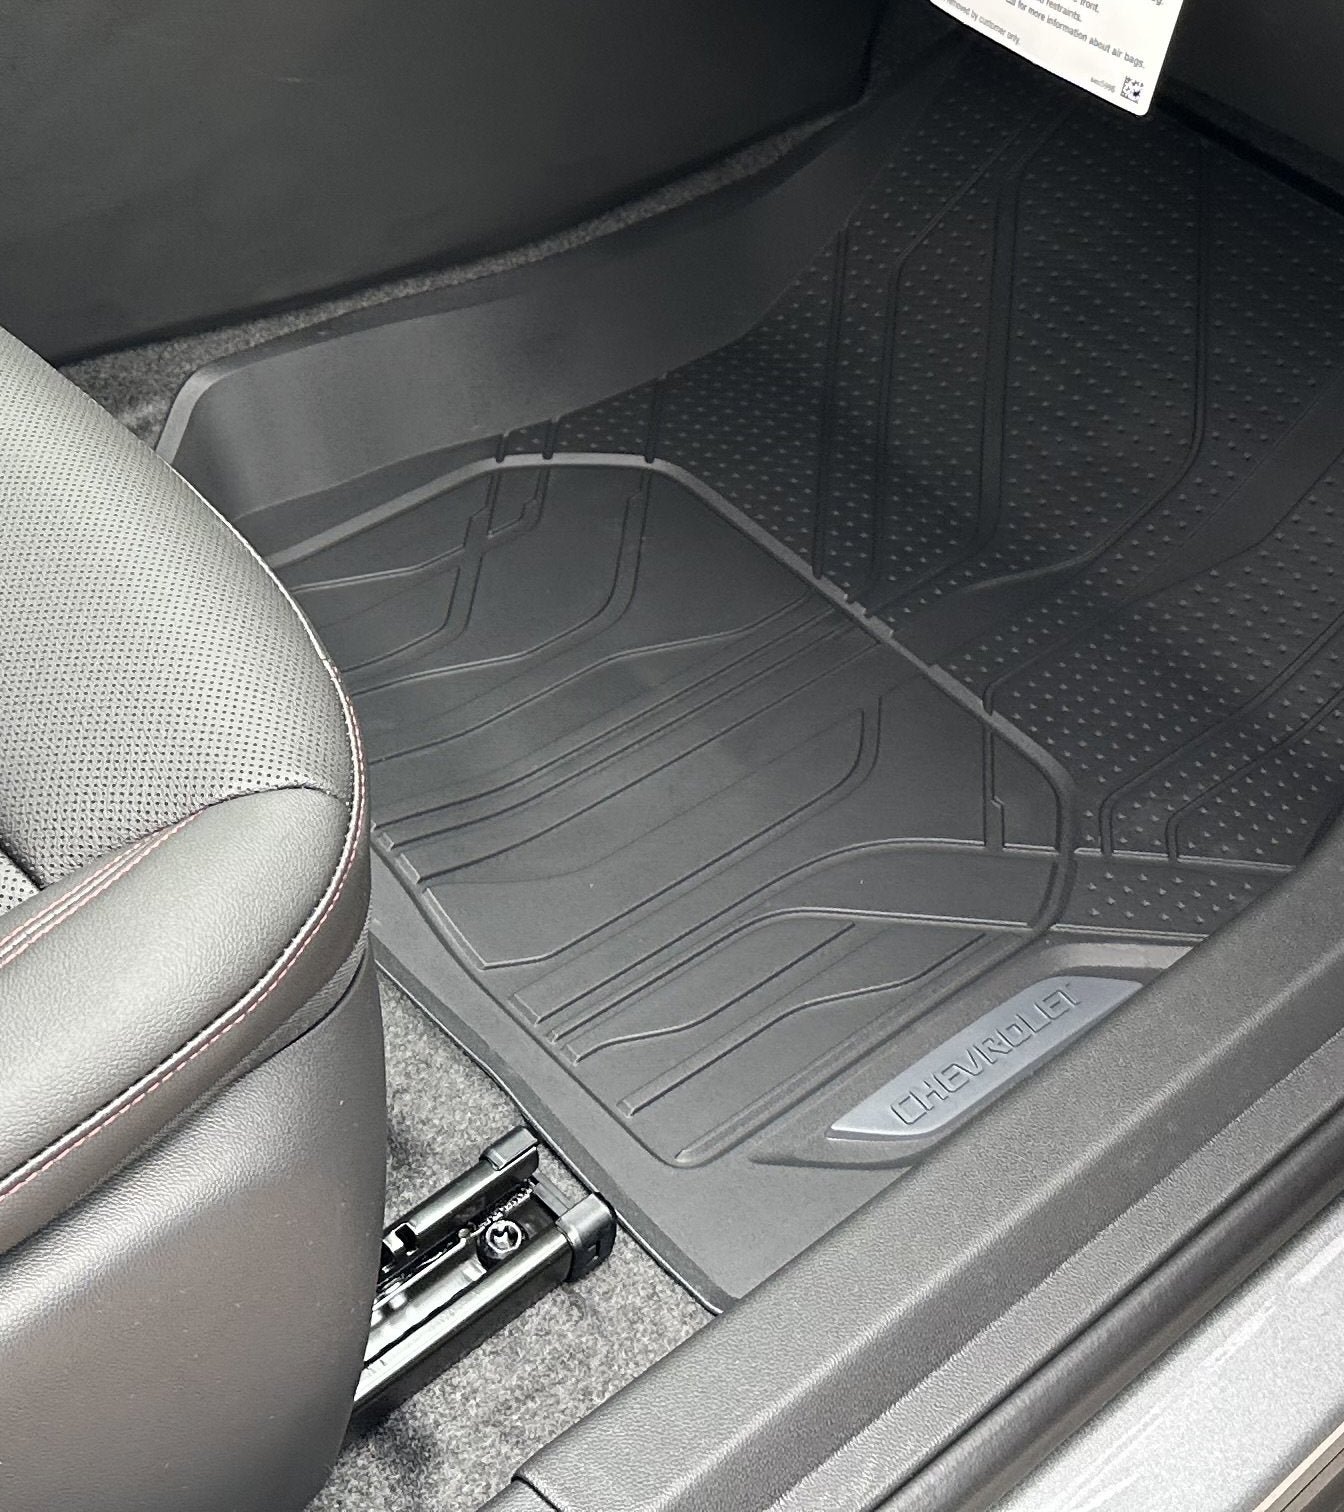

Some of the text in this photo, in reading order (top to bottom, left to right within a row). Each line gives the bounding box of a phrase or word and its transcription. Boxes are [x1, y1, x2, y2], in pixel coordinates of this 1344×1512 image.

[1028, 7, 1046, 21] more
[1089, 37, 1111, 53] about
[1111, 48, 1122, 58] air
[890, 982, 1082, 1126] CHEVROLET
